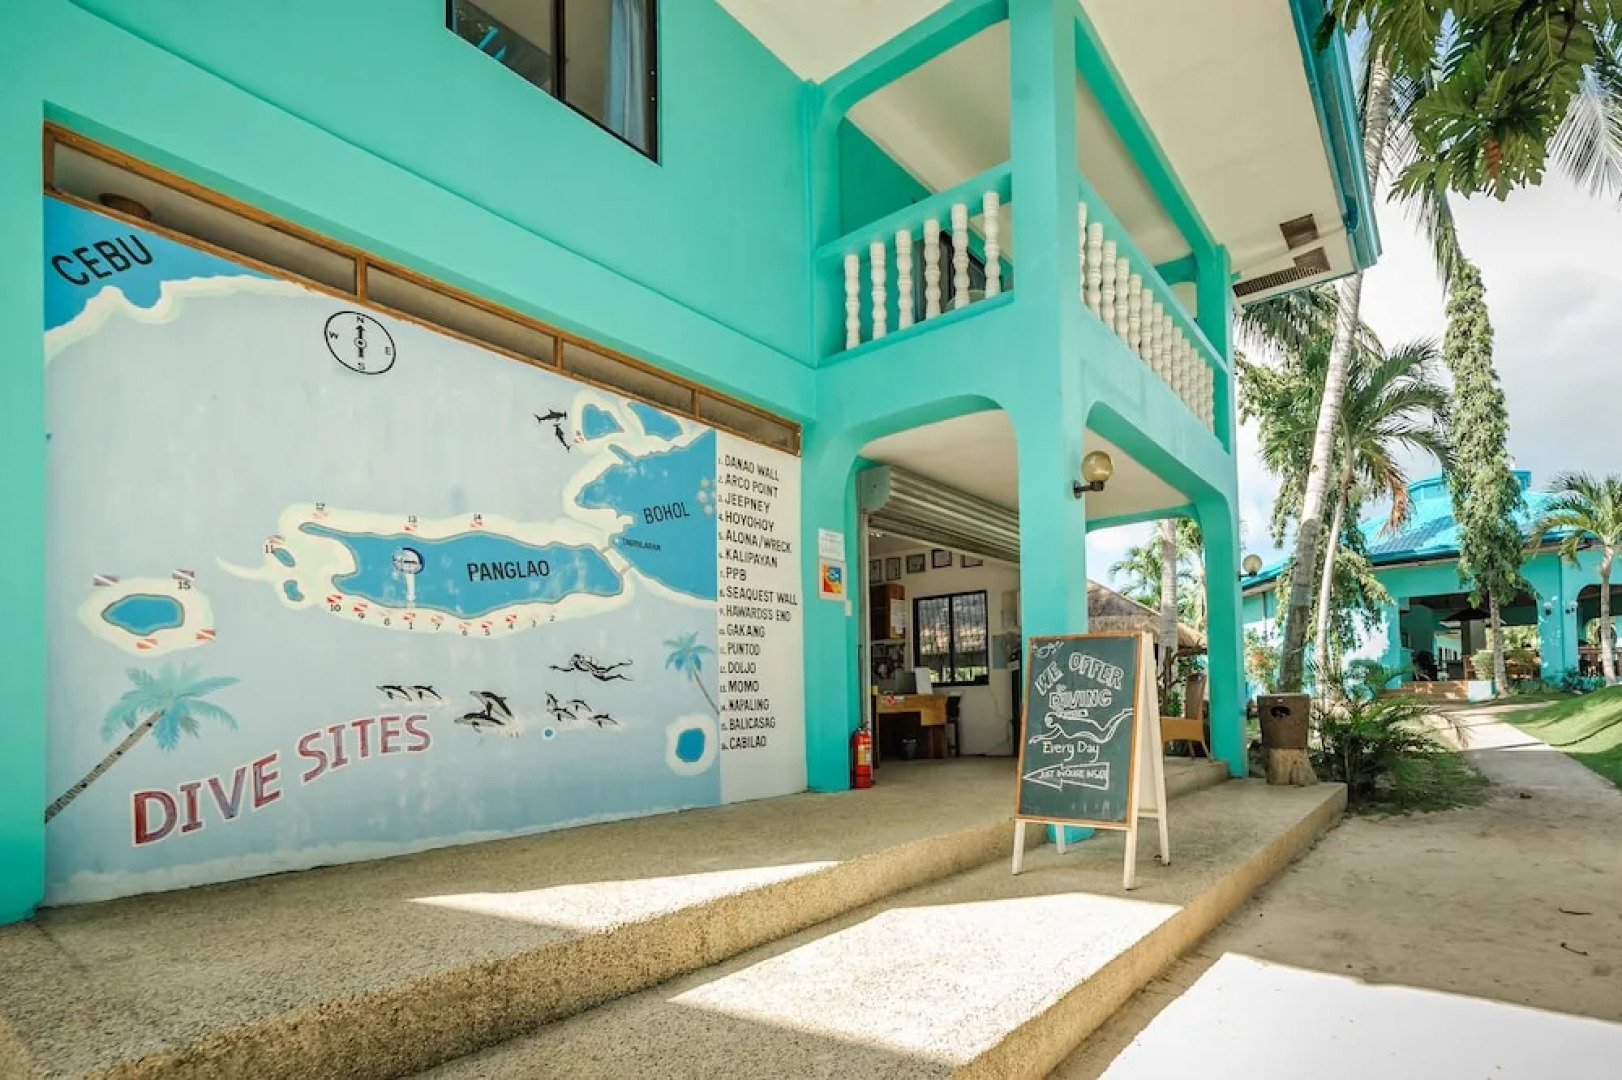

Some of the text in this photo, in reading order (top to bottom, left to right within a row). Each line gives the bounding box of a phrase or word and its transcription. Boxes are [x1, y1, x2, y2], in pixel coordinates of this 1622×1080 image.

[51, 234, 153, 286] CEBU
[356, 315, 365, 323] N
[329, 331, 339, 339] W
[385, 346, 391, 355] E
[725, 454, 755, 474] DANAO
[757, 464, 779, 482] WALL
[725, 473, 750, 491] ARCO
[752, 481, 778, 498] POINT
[643, 501, 691, 524] BOHOL
[725, 493, 770, 513] JEEPNEY
[725, 510, 774, 533] HOYOHOY
[725, 548, 778, 568] KALIPAYAN
[467, 560, 549, 582] PANGLAO
[726, 566, 747, 581] PPB
[177, 580, 191, 590] 15
[726, 585, 773, 602] SEAQUEST
[777, 591, 798, 605] WALL
[330, 603, 341, 612] 10
[726, 623, 765, 638] GAKANG
[728, 661, 756, 674] DOLJO
[1068, 651, 1125, 691] OFFER
[728, 680, 759, 693] MOMO
[1049, 688, 1112, 709] DIVING
[729, 717, 776, 731] BALICASAG
[729, 735, 767, 750] CABILAO
[1042, 740, 1100, 763] Every Day
[130, 713, 432, 848] DIVE SITES
